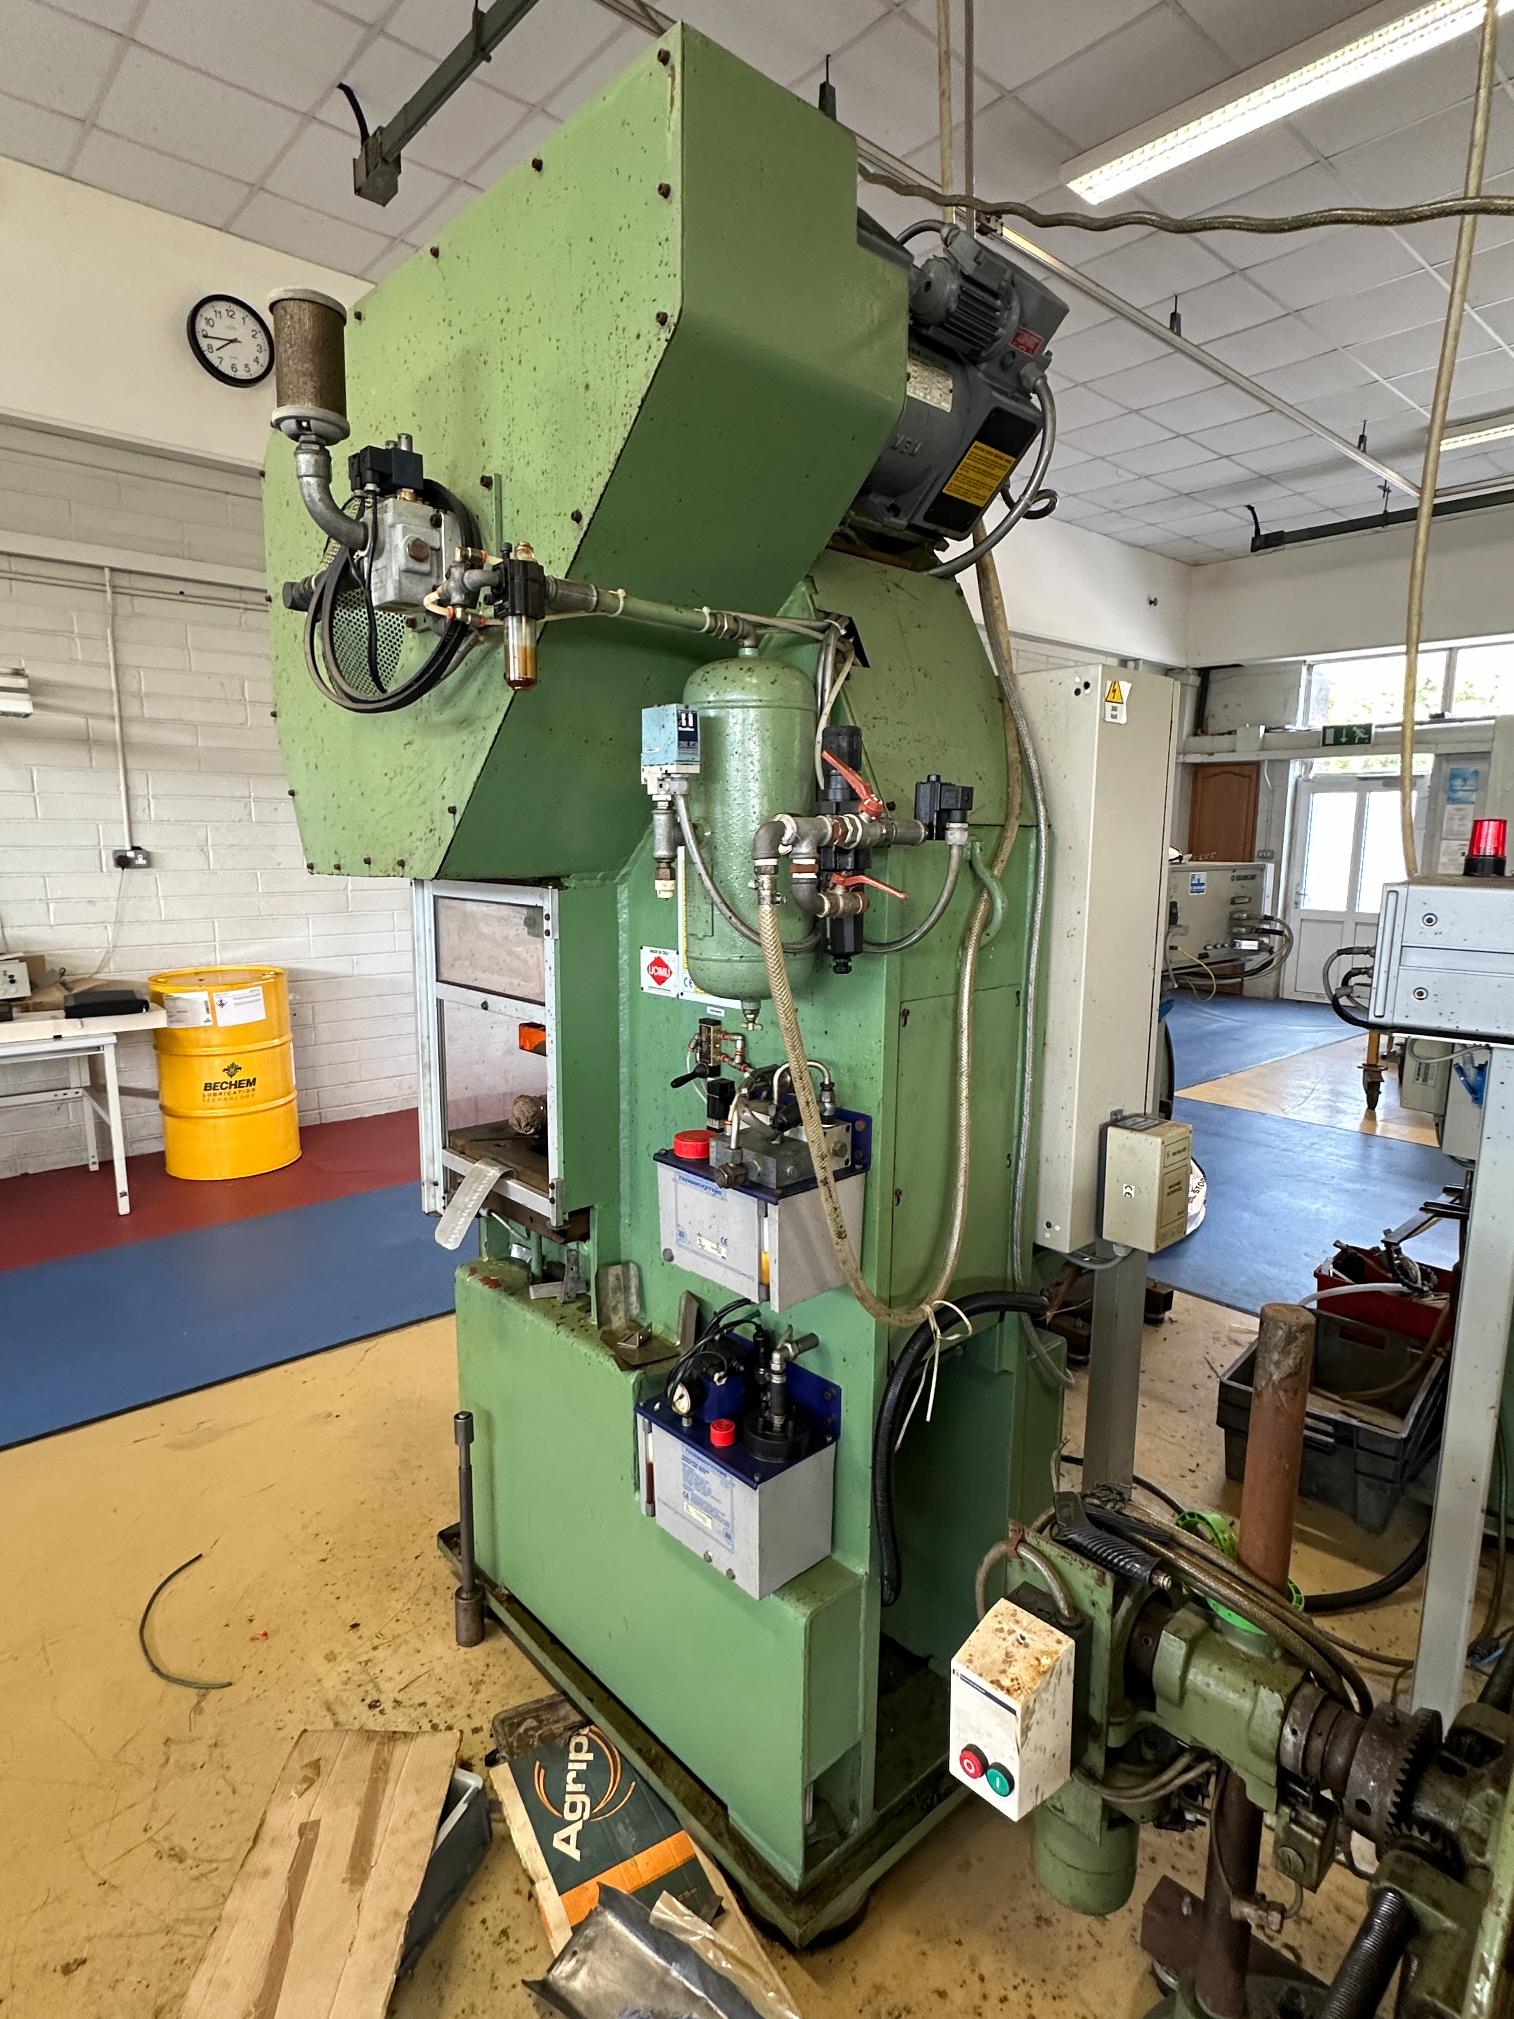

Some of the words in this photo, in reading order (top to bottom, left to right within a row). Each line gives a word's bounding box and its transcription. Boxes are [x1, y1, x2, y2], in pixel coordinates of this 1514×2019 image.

[214, 309, 222, 319] 11
[226, 309, 235, 319] 12
[204, 317, 215, 328] 10
[241, 316, 246, 326] 1
[251, 329, 258, 339] 2
[207, 344, 214, 354] 8
[256, 344, 263, 354] 3
[217, 356, 224, 366] 7
[253, 356, 260, 365] 4
[230, 363, 238, 373] 6
[244, 363, 251, 373] 5
[203, 1077, 257, 1092] BECHEM
[202, 1088, 256, 1098] LUBRICATION
